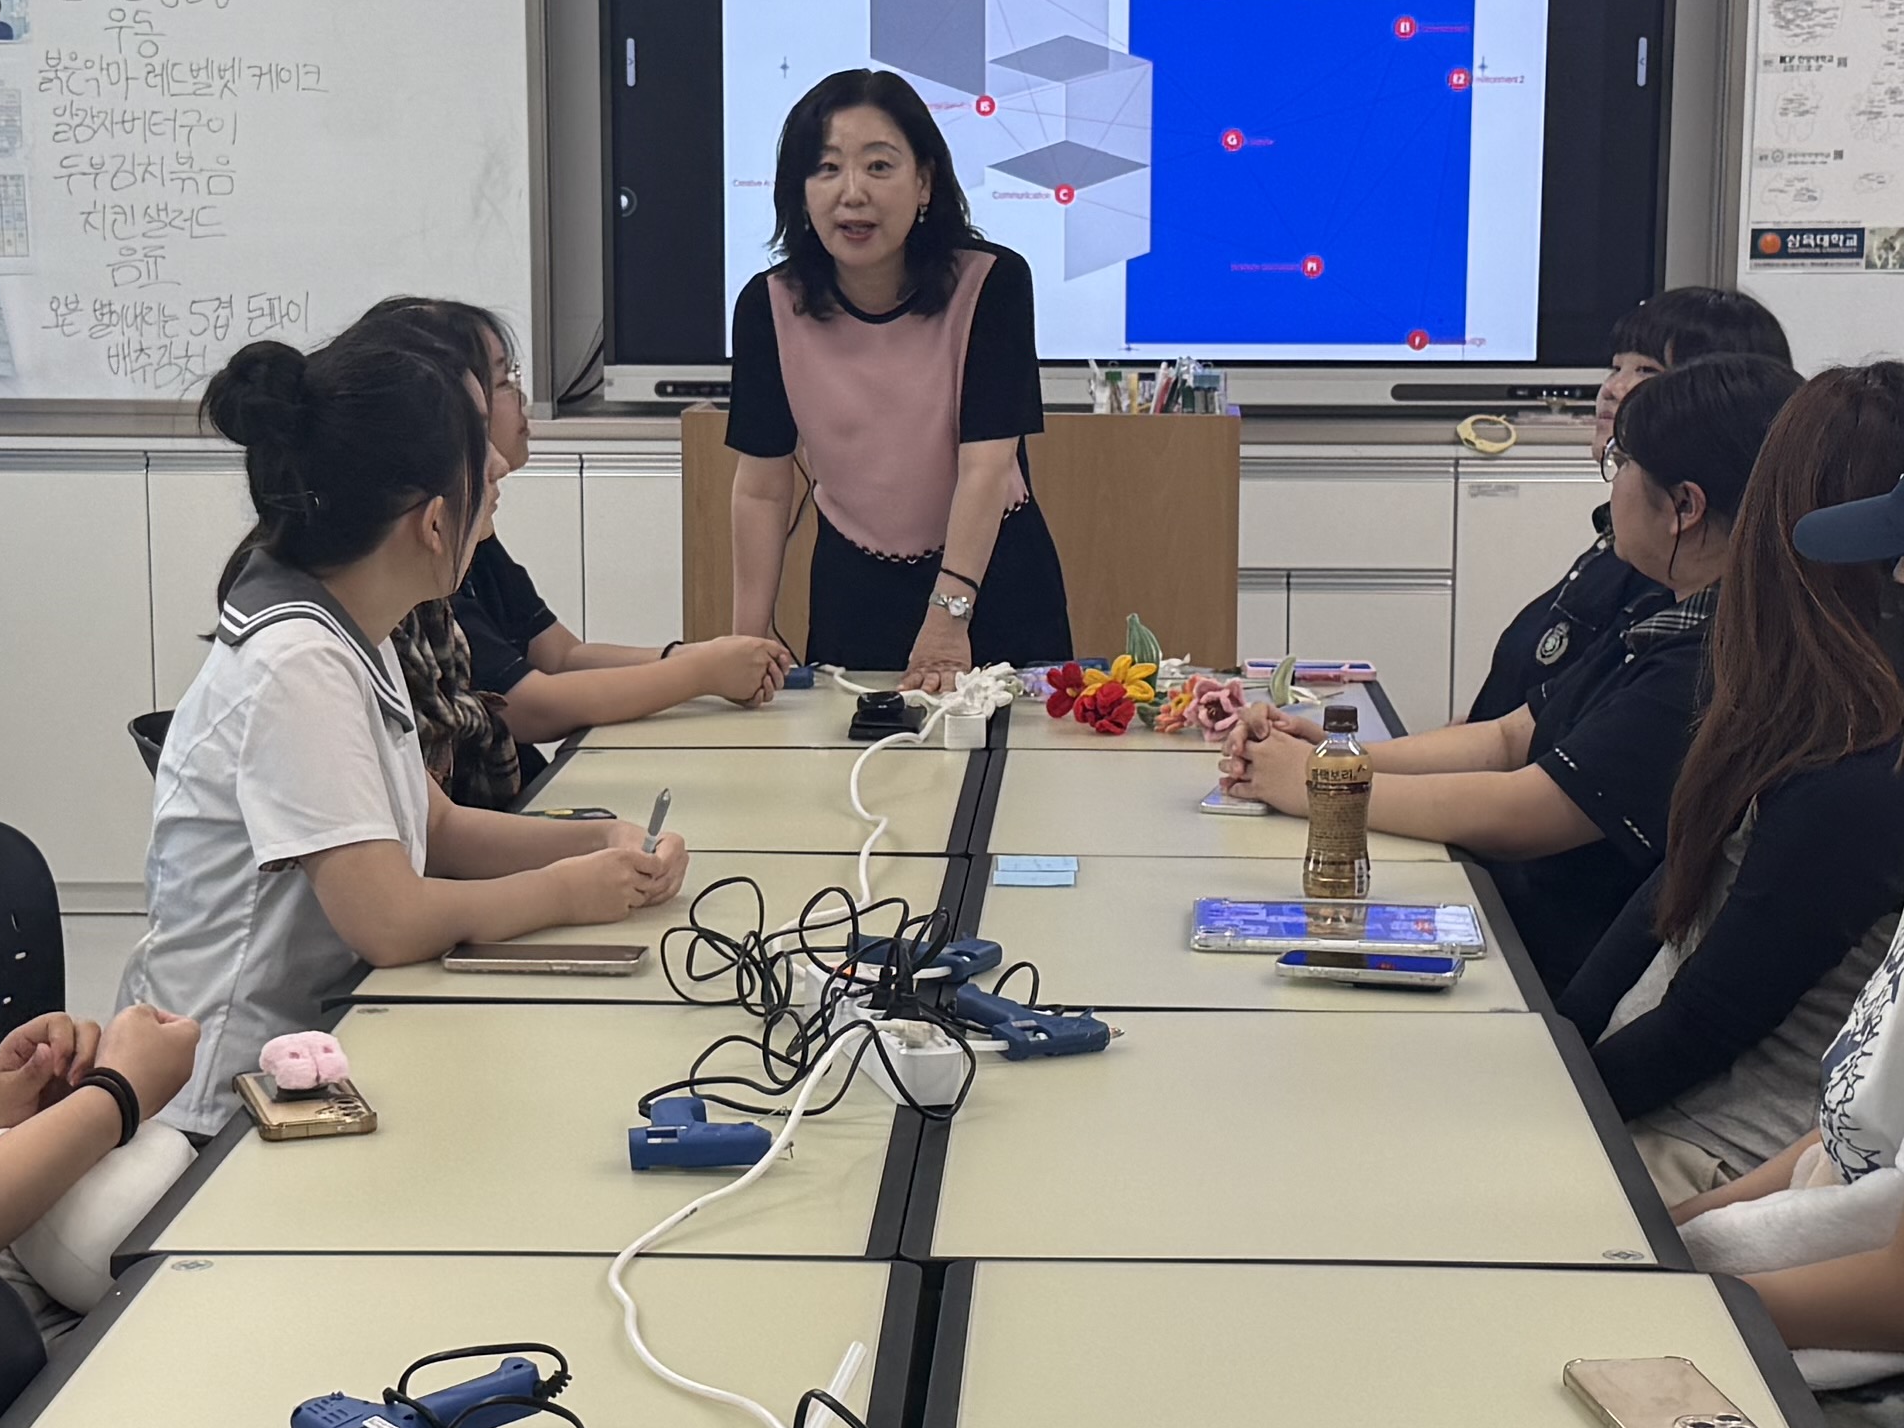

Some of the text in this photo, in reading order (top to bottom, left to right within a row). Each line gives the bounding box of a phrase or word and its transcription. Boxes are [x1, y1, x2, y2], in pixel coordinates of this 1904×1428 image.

[104, 8, 166, 59] 우동
[247, 63, 329, 93] 케이크
[80, 200, 227, 241] 치킨샐러드
